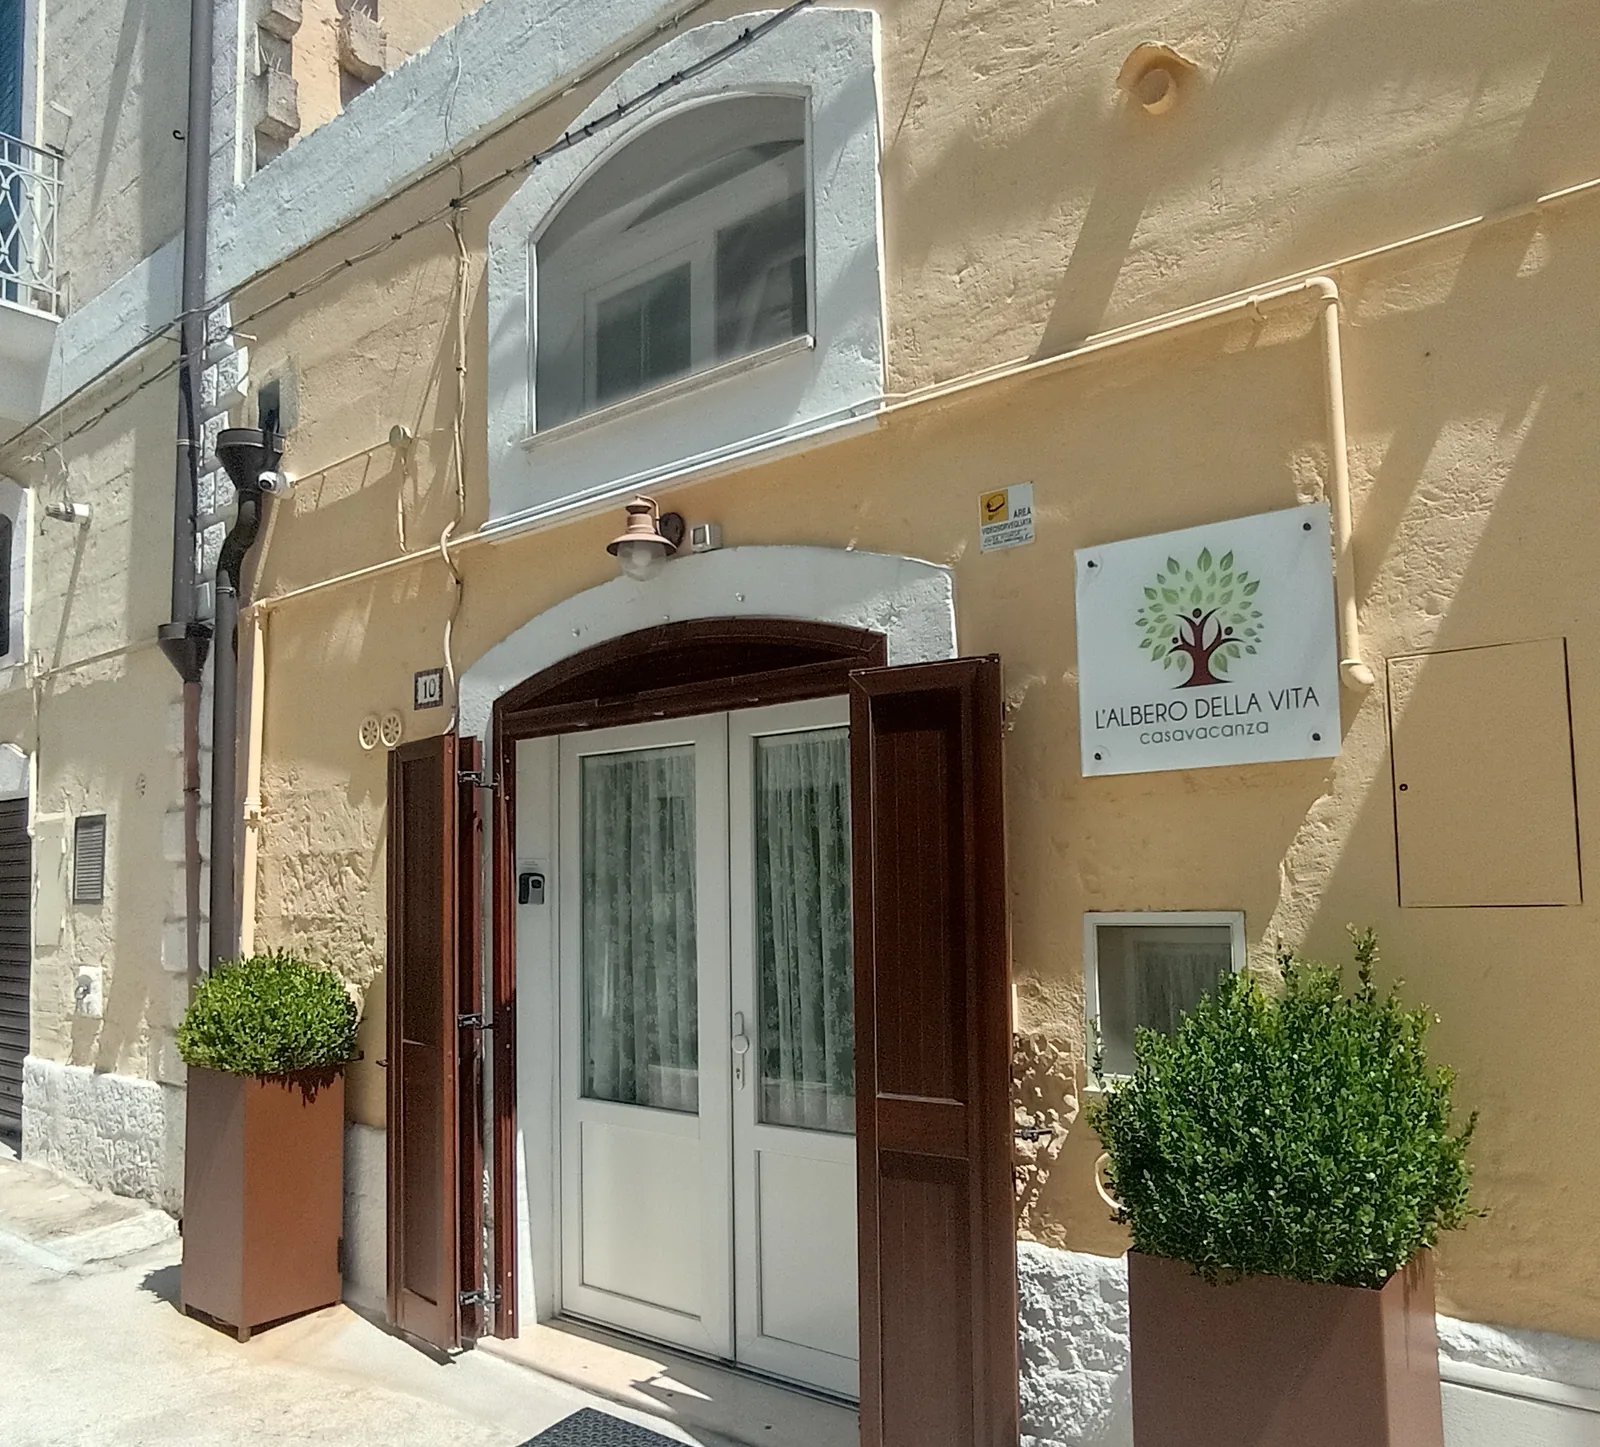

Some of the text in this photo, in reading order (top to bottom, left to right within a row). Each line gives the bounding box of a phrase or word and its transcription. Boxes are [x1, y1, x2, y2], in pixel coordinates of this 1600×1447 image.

[1013, 507, 1031, 518] AREA
[423, 678, 436, 699] 10
[1095, 686, 1319, 729] L'ALBERO DELLA VITA
[1140, 721, 1269, 745] casavacanza
